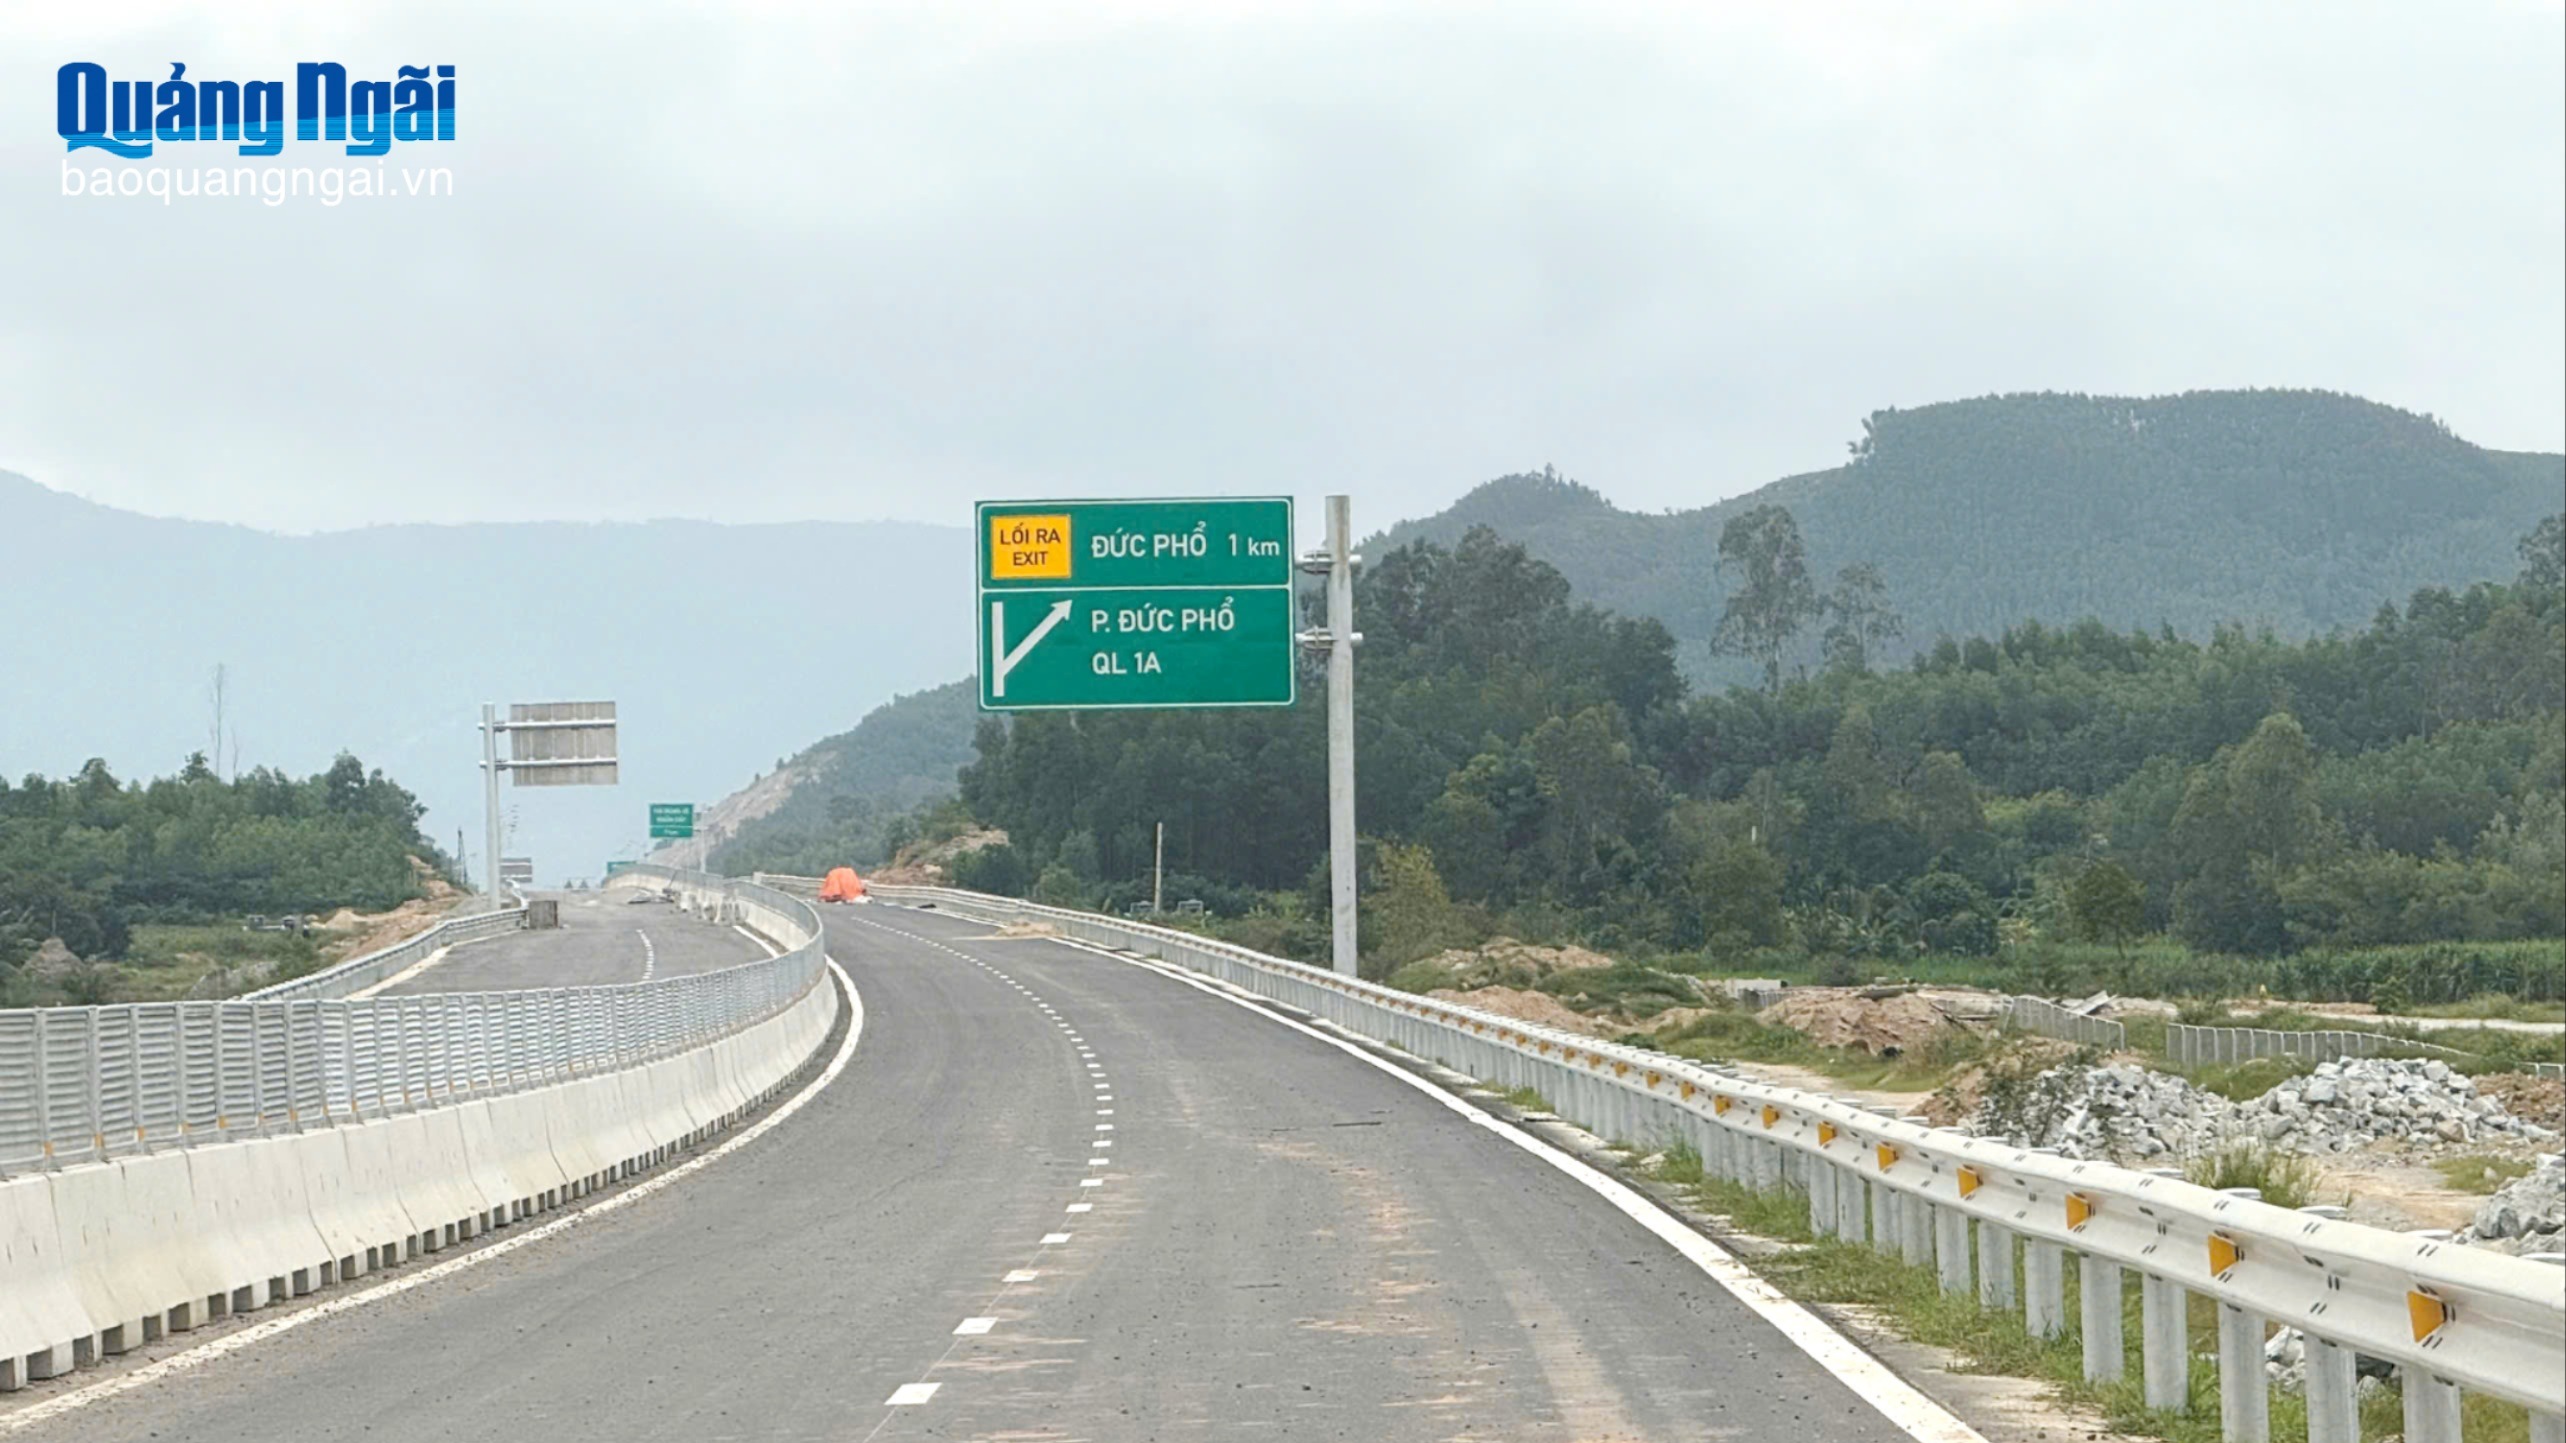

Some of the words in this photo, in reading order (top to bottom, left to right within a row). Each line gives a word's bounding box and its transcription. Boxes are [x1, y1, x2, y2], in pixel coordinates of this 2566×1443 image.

[1000, 522, 1030, 545] LỐI
[1036, 528, 1061, 544] RA
[1091, 527, 1146, 558] ĐỨC
[1153, 521, 1207, 557] PHỔ
[1228, 533, 1237, 556] 1
[1248, 537, 1280, 556] km
[1013, 551, 1048, 566] EXIT
[1091, 609, 1111, 633] P.
[1118, 602, 1174, 632] ĐỨC
[1182, 596, 1235, 631] PHỔ
[1092, 652, 1127, 675] QL
[1134, 652, 1161, 674] 1A
